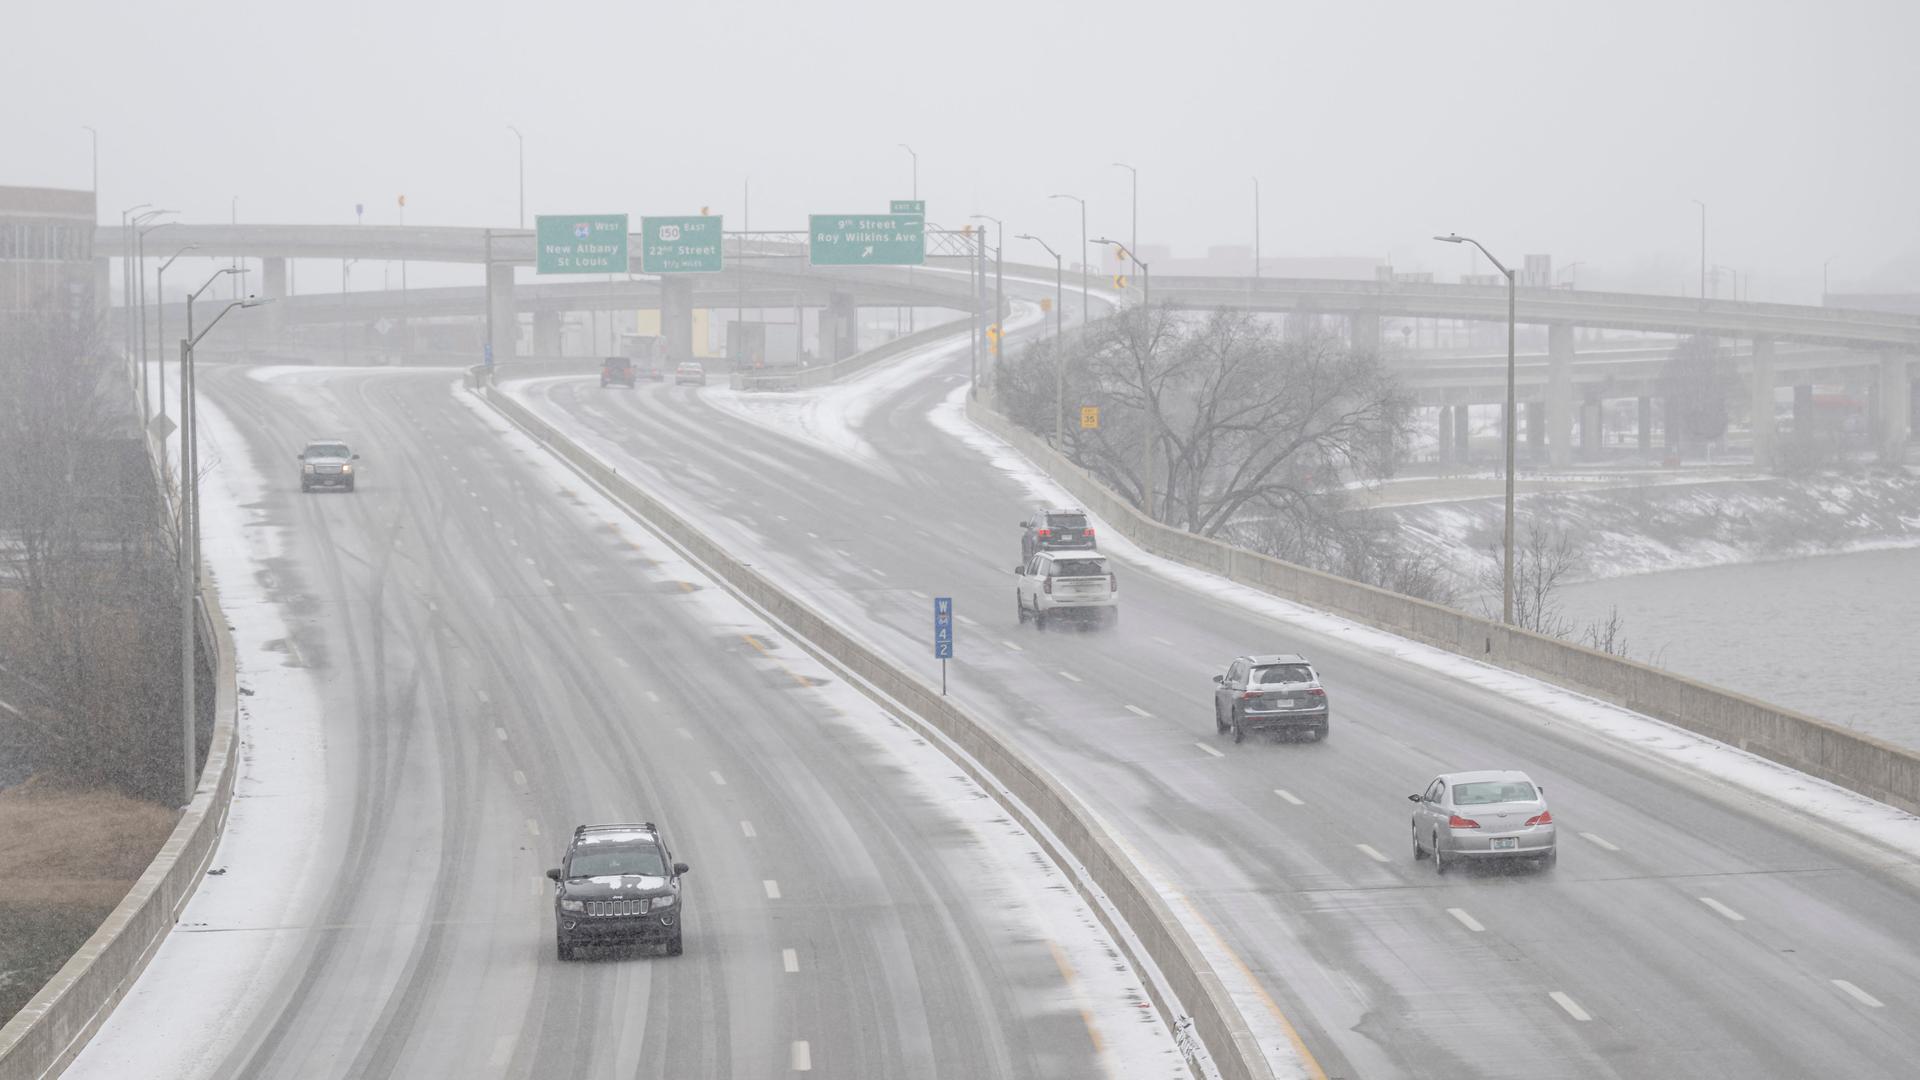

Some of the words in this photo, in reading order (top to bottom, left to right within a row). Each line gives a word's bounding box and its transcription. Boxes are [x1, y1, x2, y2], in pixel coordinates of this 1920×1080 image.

[859, 220, 896, 229] Street
[661, 228, 679, 238] 150
[817, 233, 840, 245] Roy
[845, 232, 889, 242] Wilkins
[895, 233, 917, 242] Ave
[546, 245, 571, 254] New
[576, 244, 618, 255] Albany
[678, 245, 715, 255] Street
[558, 257, 569, 266] St
[575, 257, 608, 266] Louis
[1084, 415, 1095, 424] 35
[938, 600, 948, 612] W
[939, 628, 947, 639] 4
[940, 644, 948, 655] 2
